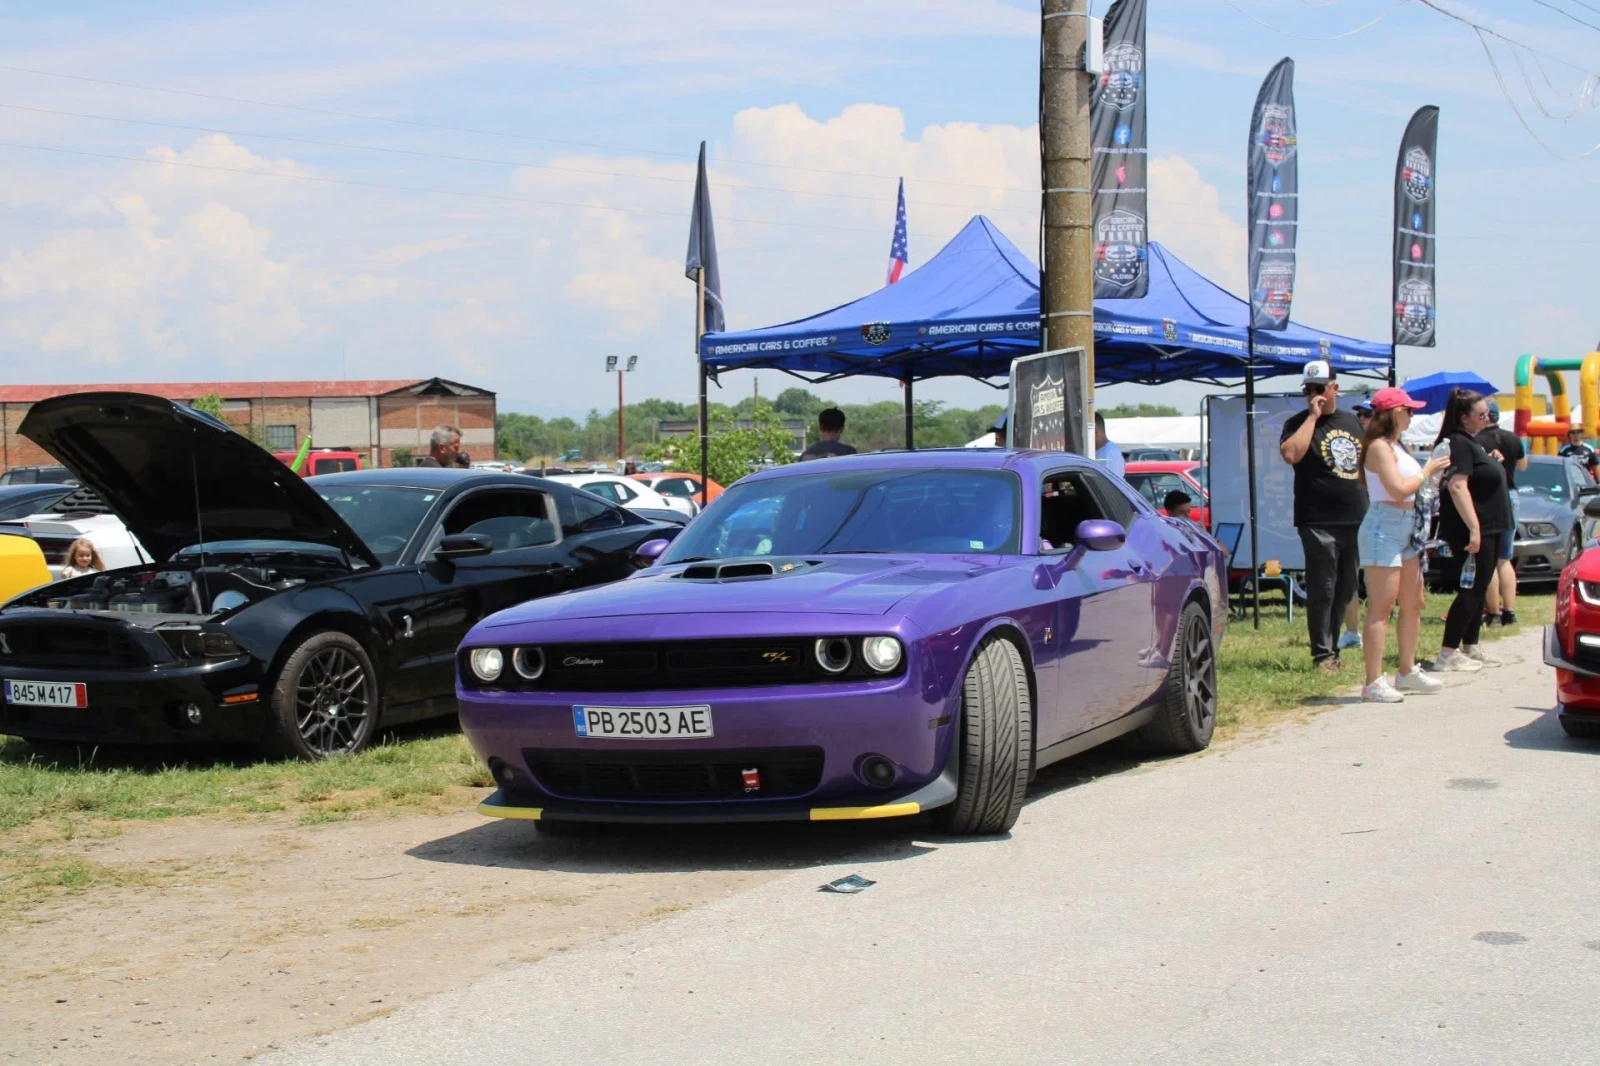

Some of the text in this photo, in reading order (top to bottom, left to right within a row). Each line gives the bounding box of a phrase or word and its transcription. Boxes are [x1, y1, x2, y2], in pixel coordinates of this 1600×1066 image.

[928, 323, 977, 335] AMERICAN
[979, 322, 1004, 332] CARS
[1006, 322, 1013, 331] &
[715, 337, 828, 354] AMERICAN CARS & COFFEE
[13, 684, 72, 704] 845 M 417
[587, 710, 707, 734] PB 2503 AE
